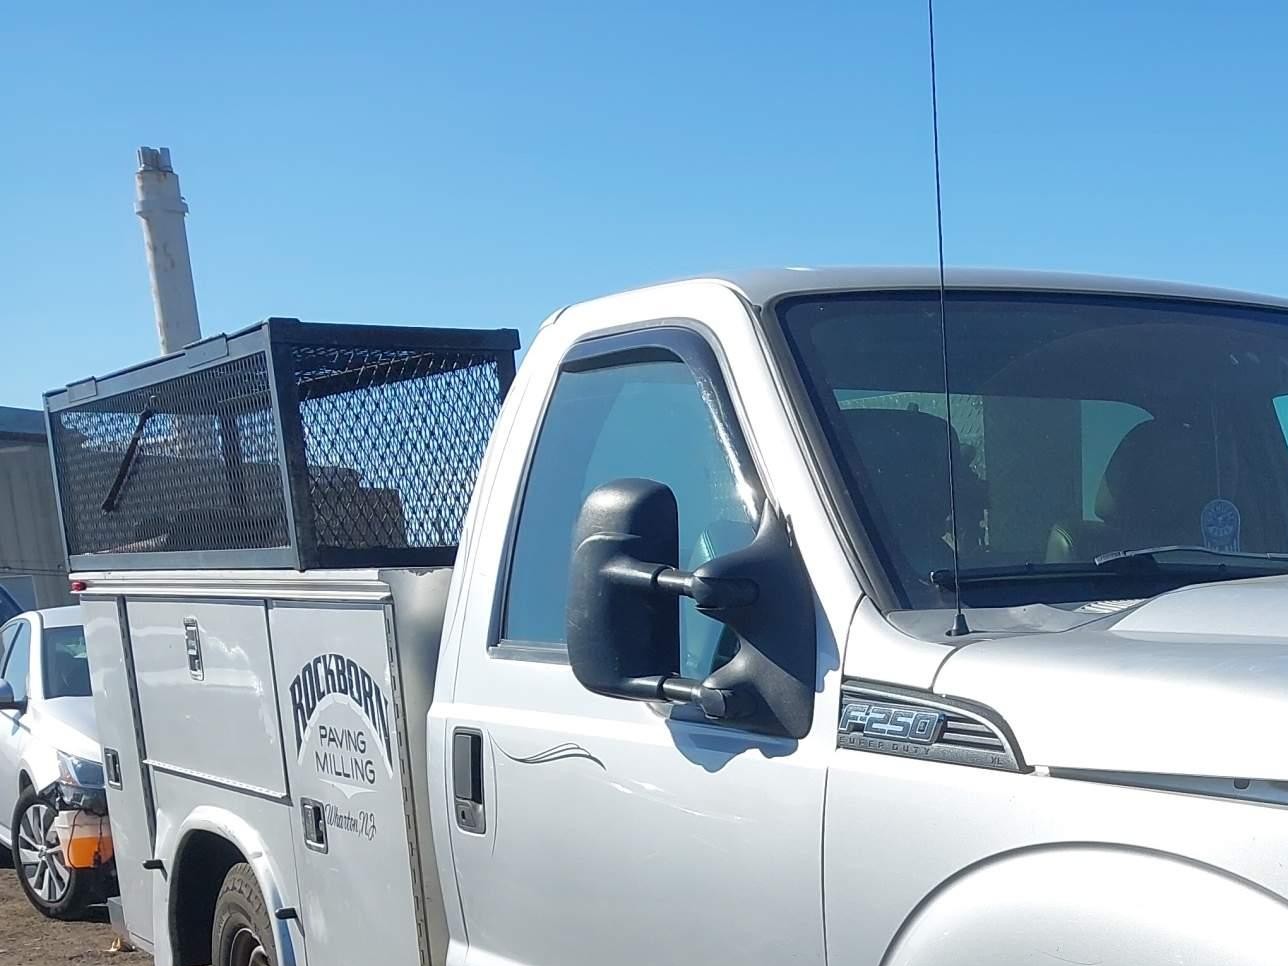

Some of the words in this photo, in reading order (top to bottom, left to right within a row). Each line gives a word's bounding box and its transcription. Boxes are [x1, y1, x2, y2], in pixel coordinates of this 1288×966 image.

[289, 653, 394, 770] ROCKBORN
[838, 703, 940, 742] F-250
[319, 725, 367, 754] PAVING
[891, 743, 931, 755] DUTY
[315, 751, 376, 785] MILLING
[359, 811, 377, 840] NJ
